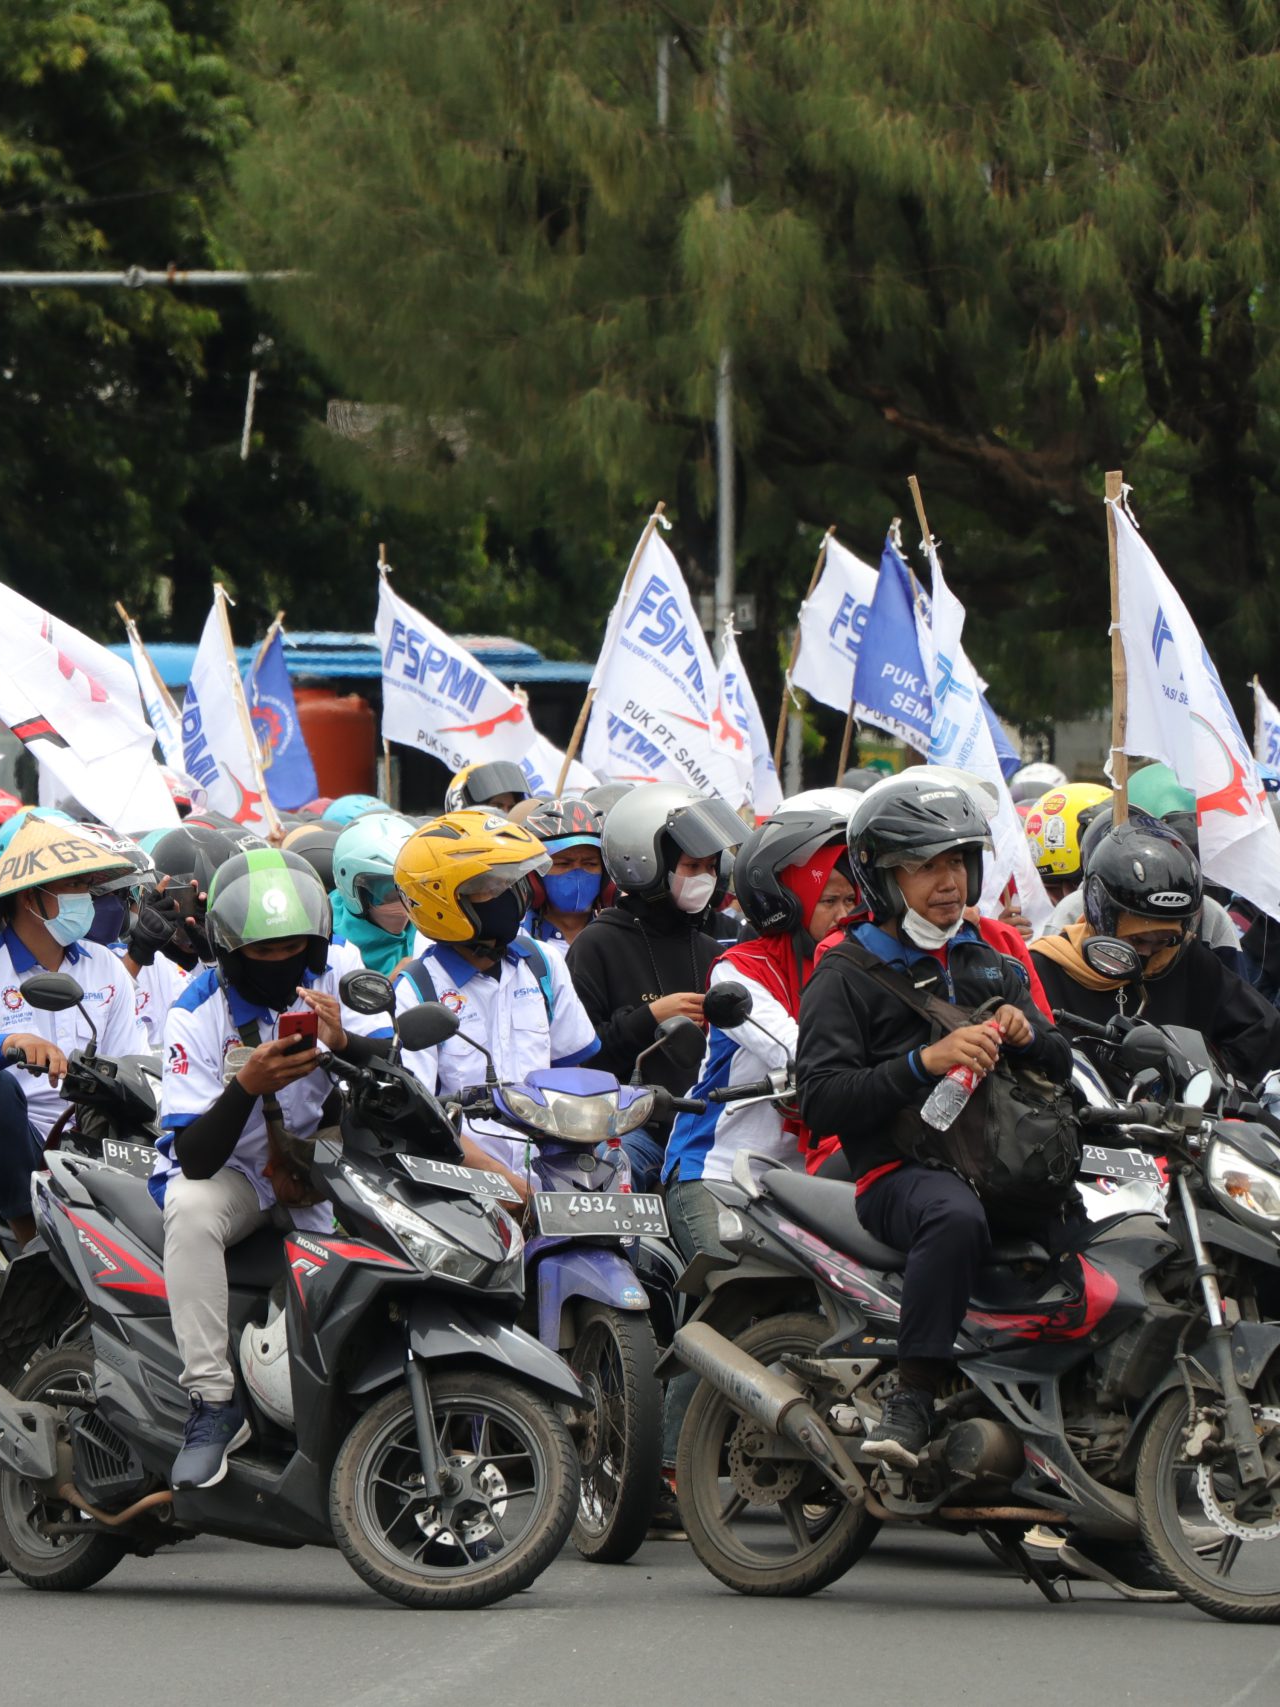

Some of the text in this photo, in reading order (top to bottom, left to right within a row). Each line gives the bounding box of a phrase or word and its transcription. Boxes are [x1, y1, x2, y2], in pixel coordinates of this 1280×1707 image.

[384, 618, 487, 713] FSPMI
[881, 663, 919, 692] PUK
[417, 729, 439, 751] PUK
[624, 700, 656, 728] PUK
[674, 748, 710, 790] SAMI
[1154, 895, 1185, 903] INK
[172, 1062, 189, 1075] all
[401, 1154, 417, 1168] K
[426, 1160, 472, 1179] 2470
[1128, 1153, 1157, 1168] LM
[540, 1196, 659, 1215] H 4934 NW
[296, 1236, 330, 1260] HONDA
